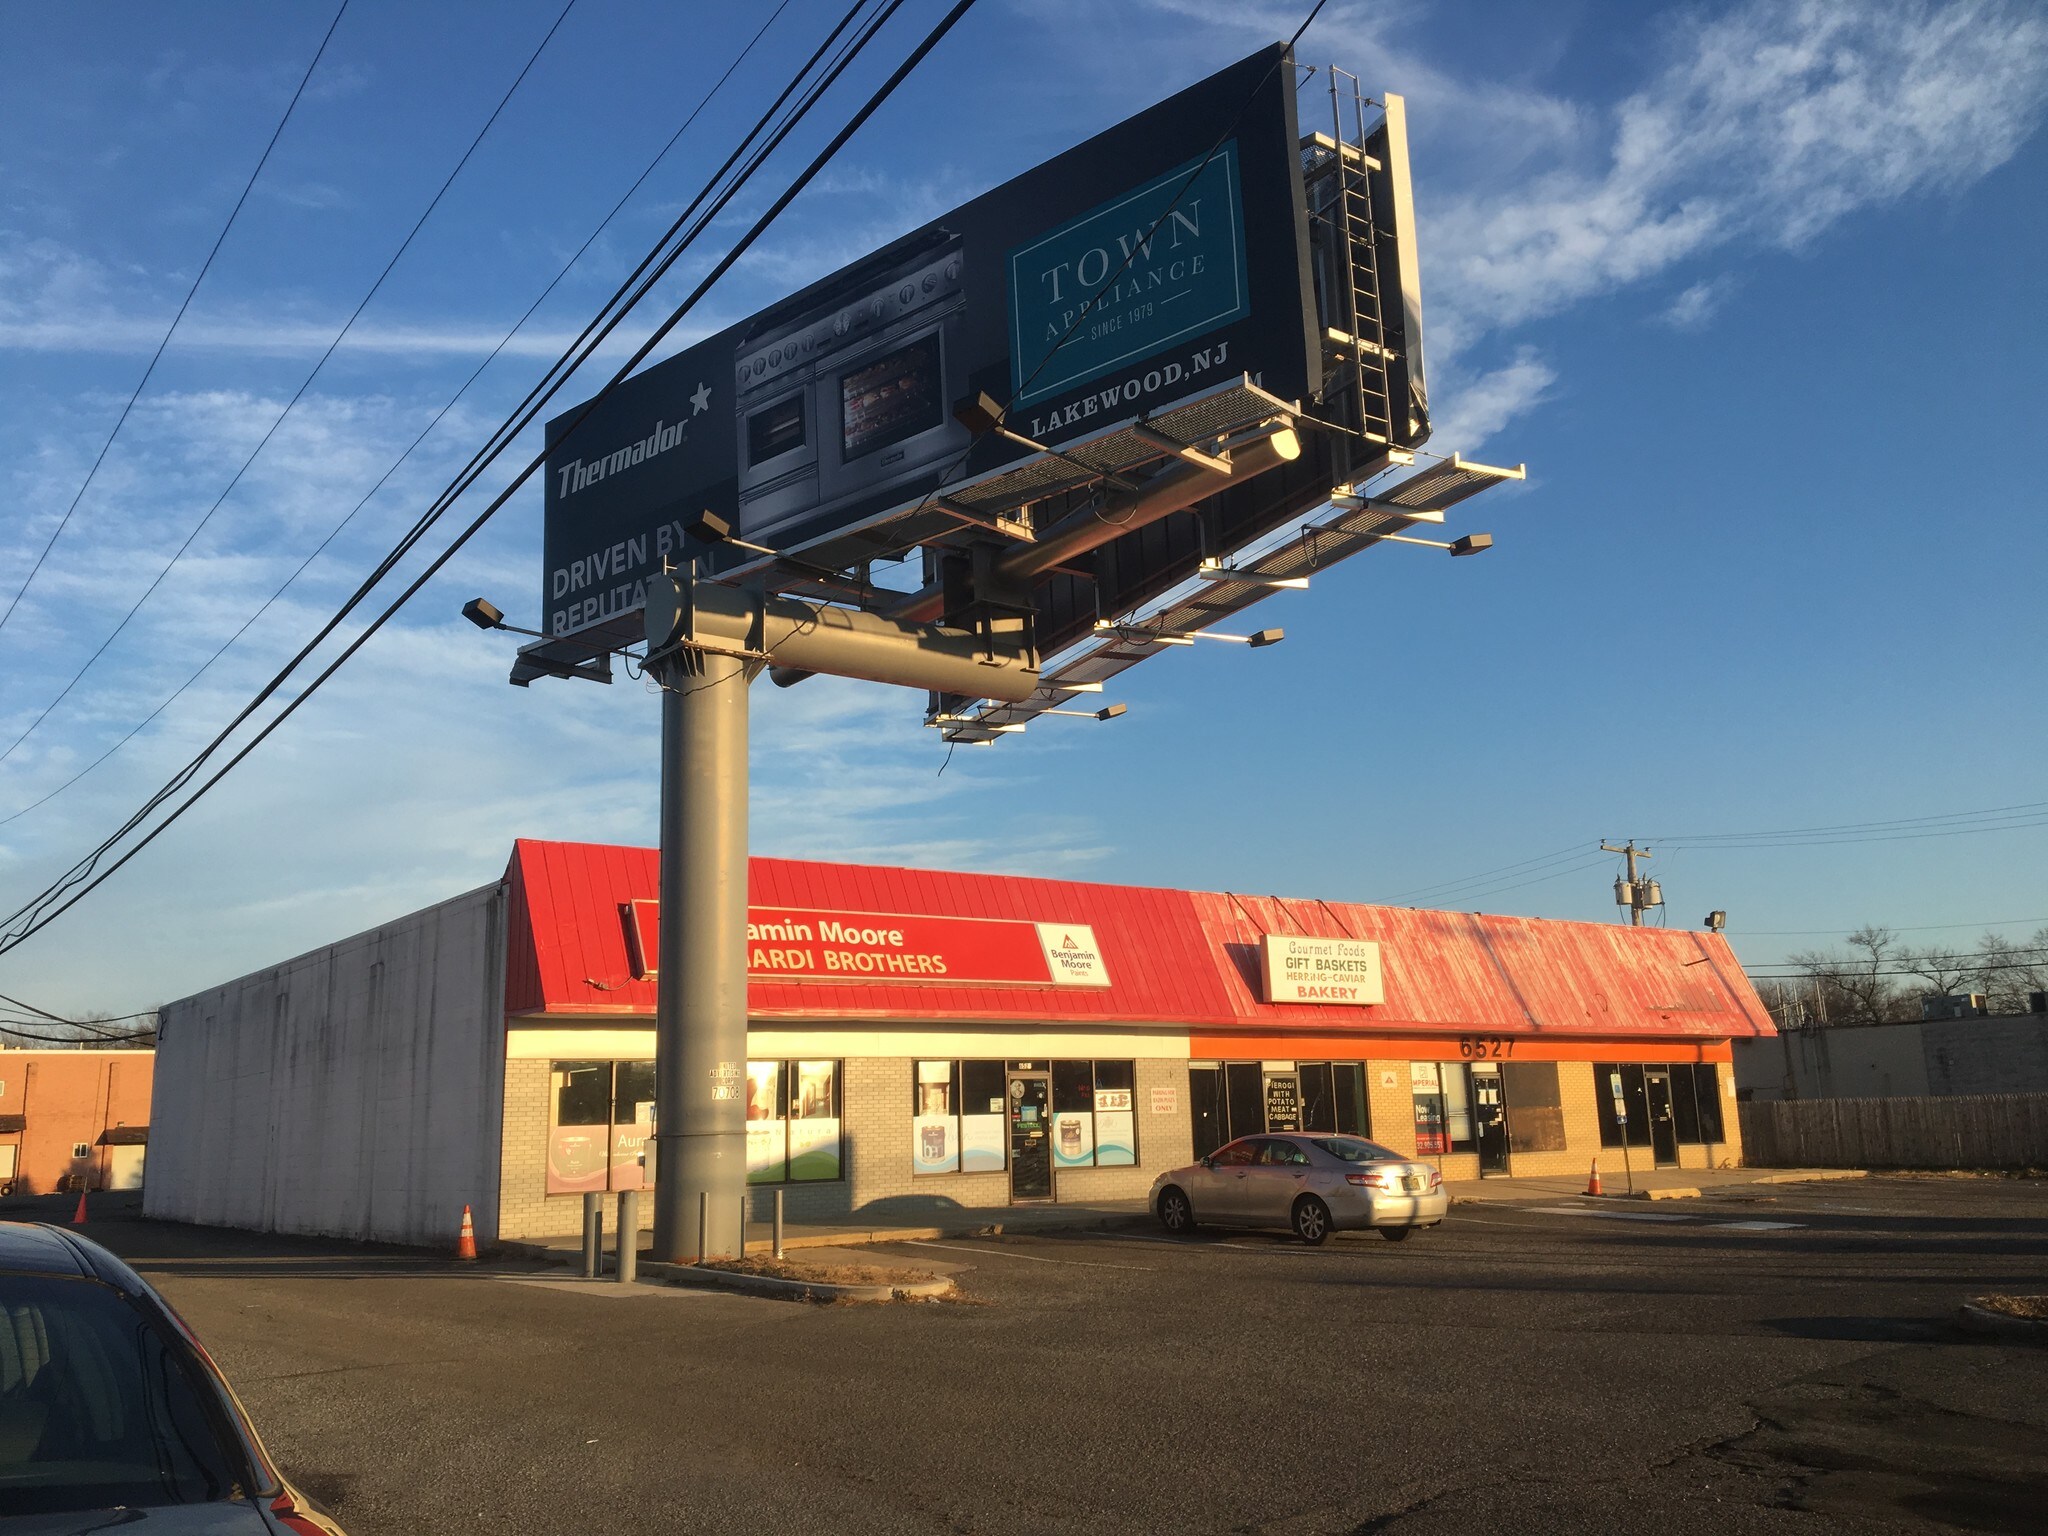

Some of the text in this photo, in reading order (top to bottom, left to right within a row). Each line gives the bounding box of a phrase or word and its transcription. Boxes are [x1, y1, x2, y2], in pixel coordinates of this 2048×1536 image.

[1041, 198, 1202, 305] TOWN
[1045, 254, 1206, 341] APPLIANCE
[1090, 302, 1154, 340] SINCE 1979
[557, 419, 689, 500] Thermador
[553, 519, 686, 601] DRIVEN BY
[818, 920, 904, 946] Moore
[1051, 949, 1096, 961] Benjamin
[1288, 940, 1366, 958] Gourmet Foods
[747, 948, 948, 975] ARDI BROTHERS
[1061, 959, 1092, 970] Moore
[1285, 956, 1368, 973] GIFT BASKETS
[1069, 969, 1089, 977] Paints
[1297, 985, 1358, 1000] BAKERY
[1460, 1036, 1516, 1059] 6527
[1272, 1090, 1291, 1098] WITH
[1155, 1104, 1173, 1112] ONLY
[1268, 1098, 1295, 1106] POTATO
[1270, 1105, 1290, 1113] MEAT
[1415, 1104, 1431, 1115] Now
[1268, 1113, 1297, 1121] CABBAGE
[1416, 1113, 1441, 1124] Leasing
